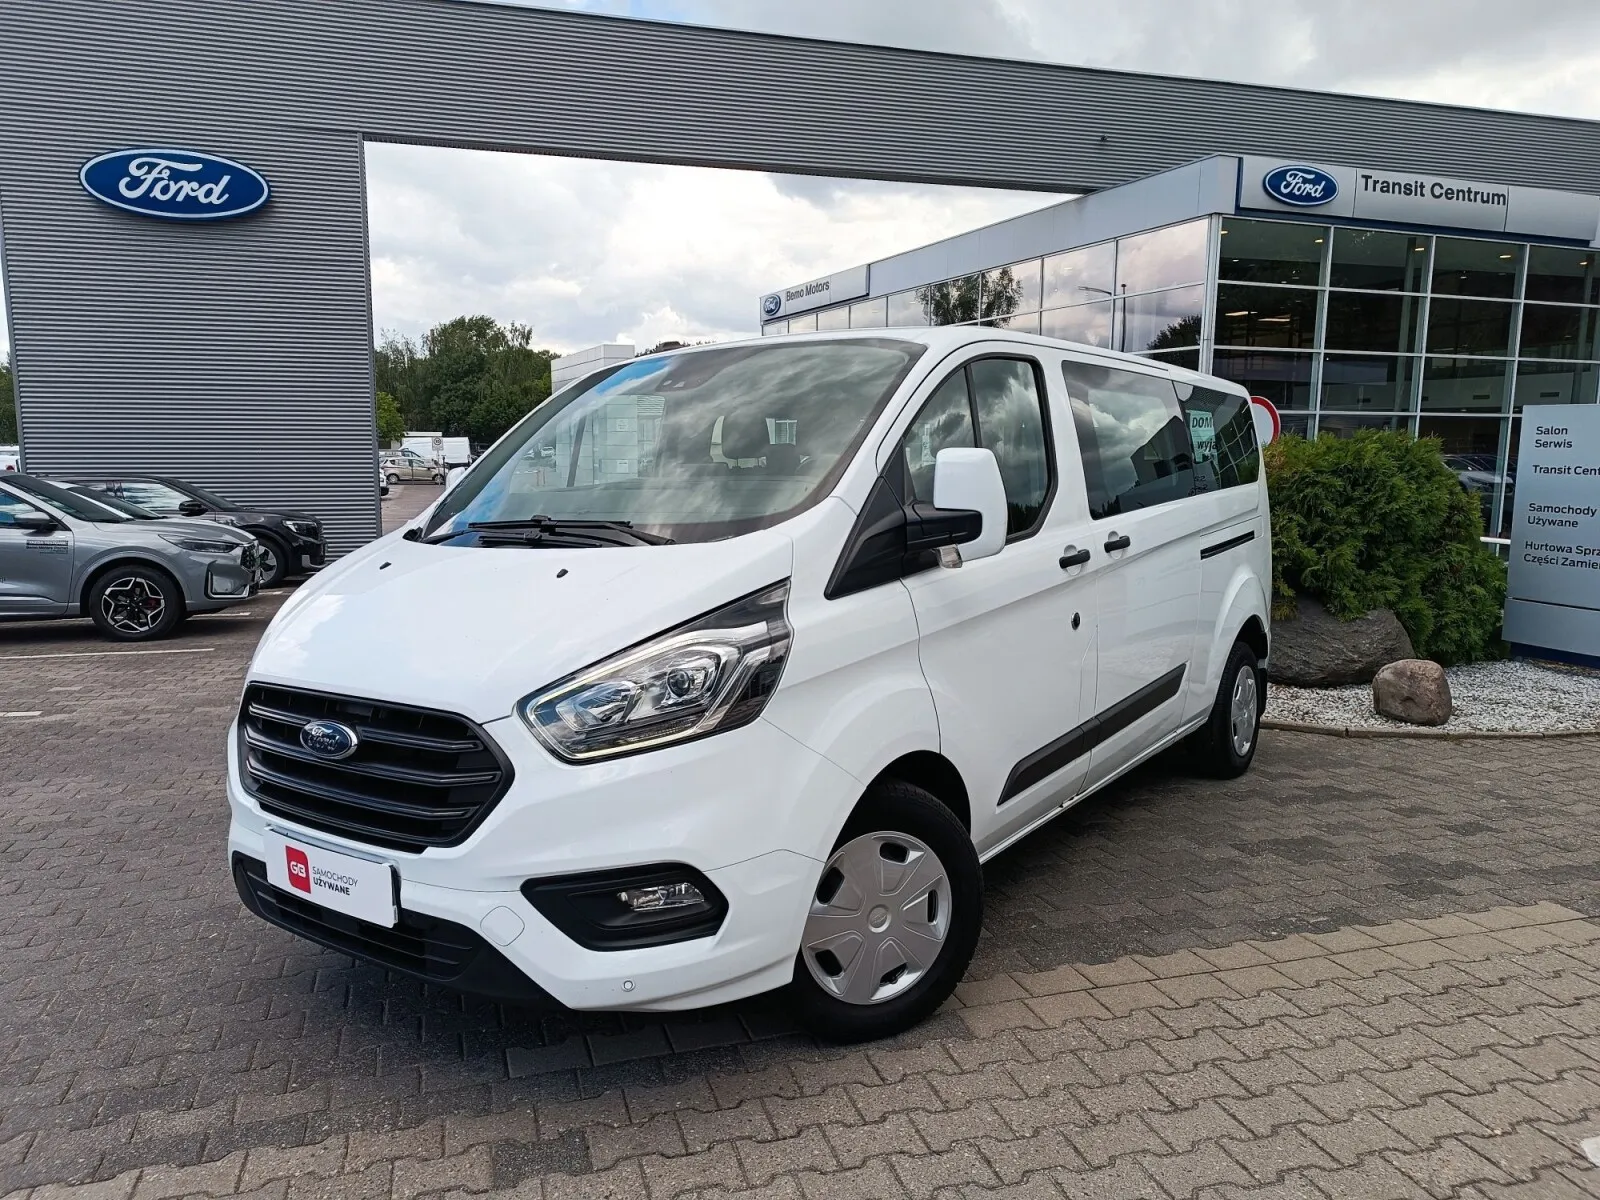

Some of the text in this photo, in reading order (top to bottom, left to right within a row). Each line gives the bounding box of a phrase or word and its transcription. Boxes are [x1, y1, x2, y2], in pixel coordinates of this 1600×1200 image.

[118, 157, 231, 205] Ford
[1280, 170, 1326, 198] Ford
[1361, 174, 1507, 206] Transit Centrum
[786, 280, 830, 302] Bemo Motors
[1535, 425, 1568, 436] Salon
[1534, 438, 1573, 449] Serwis
[1532, 464, 1571, 475] Transit
[1528, 502, 1598, 517] Samochody
[1527, 515, 1579, 528] Używane
[1525, 540, 1573, 555] Hurtowa
[1523, 552, 1600, 570] Części Zamie
[308, 725, 340, 750] Ford
[312, 866, 358, 887] SAMOCHODY
[313, 876, 350, 896] UŻYWANE
